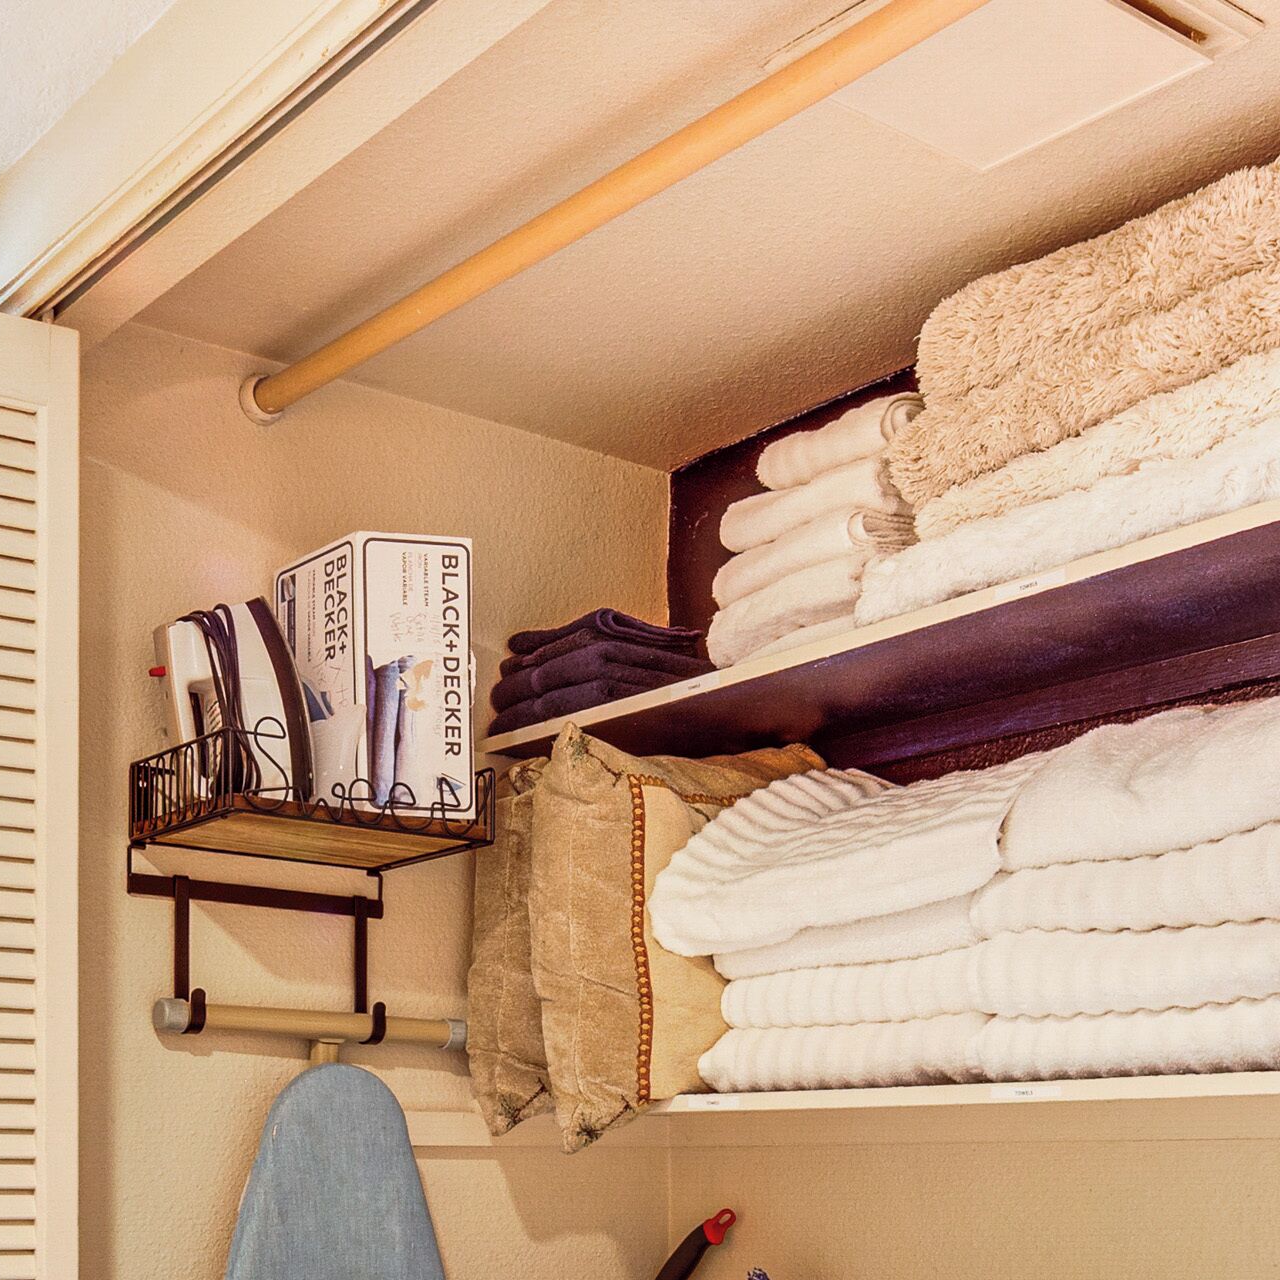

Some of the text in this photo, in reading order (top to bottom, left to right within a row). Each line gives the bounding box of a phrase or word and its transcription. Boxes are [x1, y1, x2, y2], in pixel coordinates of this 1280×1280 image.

[323, 559, 337, 662] DECKER
[335, 553, 348, 656] BLACK+
[441, 554, 461, 757] BLACK+DECKER
